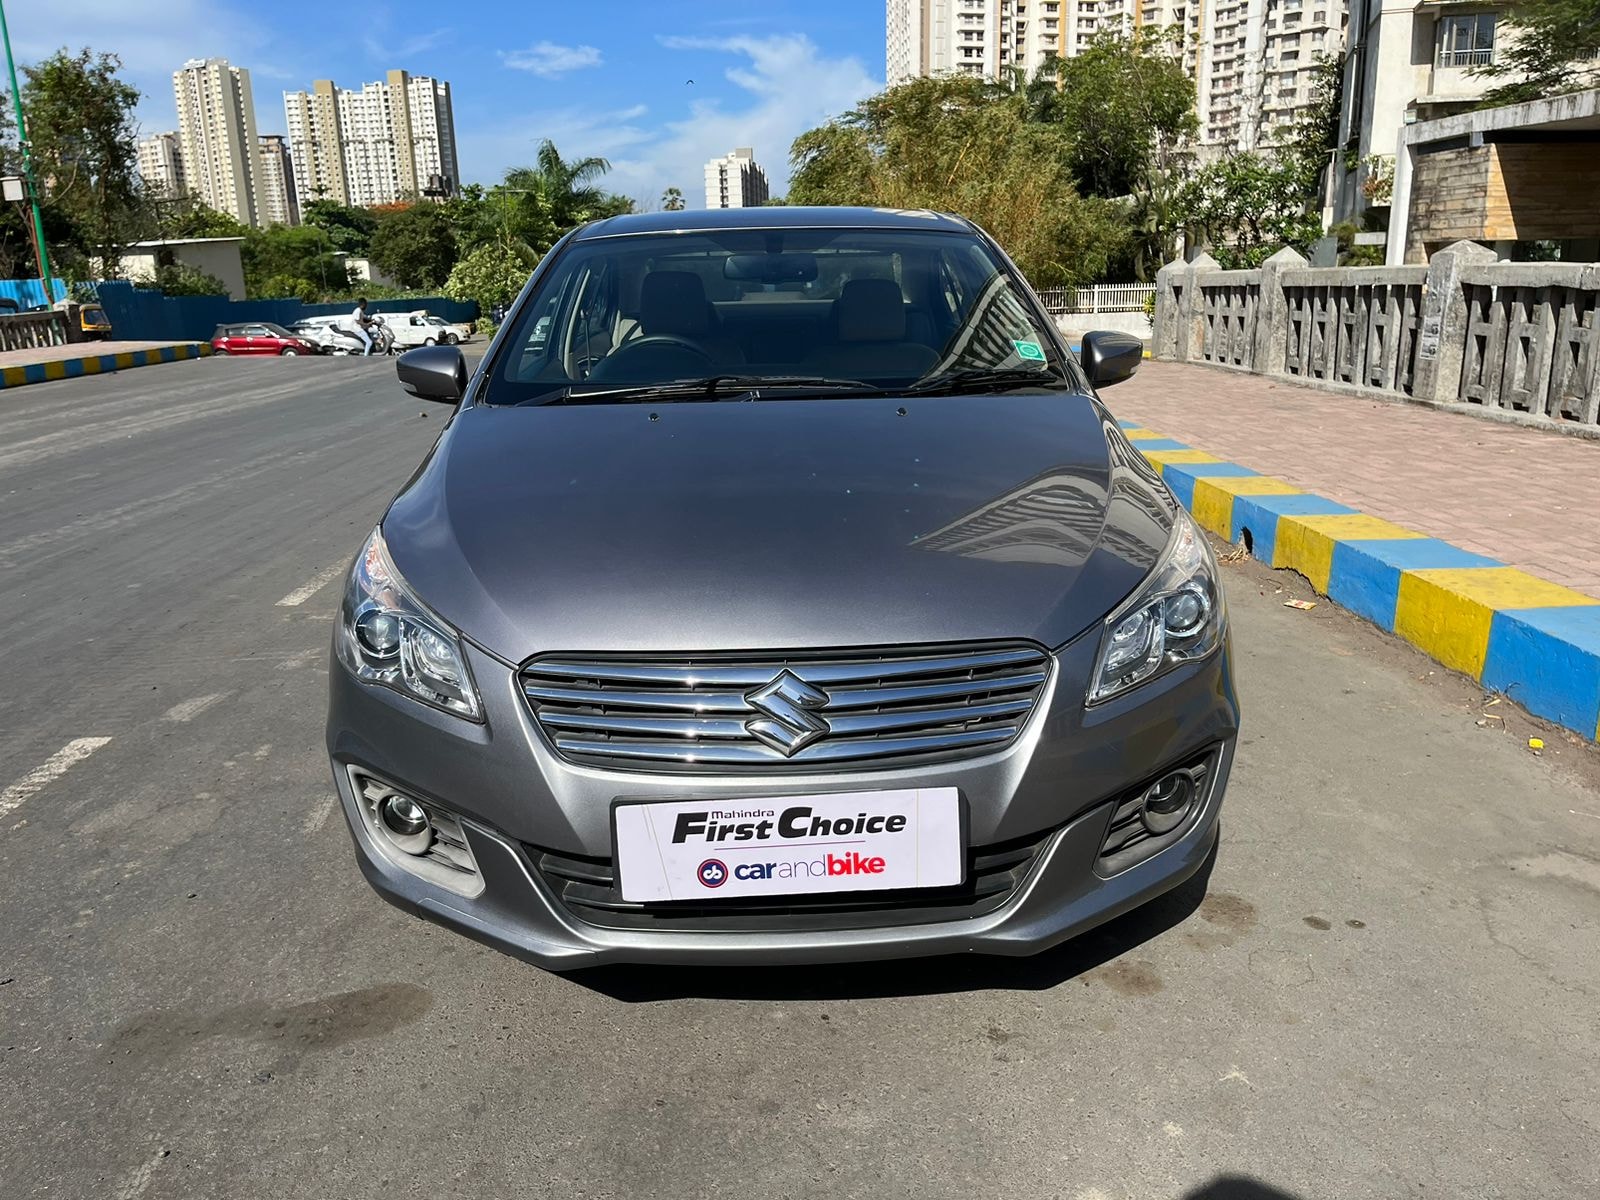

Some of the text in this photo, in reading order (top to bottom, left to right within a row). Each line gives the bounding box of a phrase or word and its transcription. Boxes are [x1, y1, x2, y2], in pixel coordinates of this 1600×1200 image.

[672, 806, 907, 844] First Choice
[711, 809, 775, 820] Mahindra
[734, 851, 886, 881] carandbike
